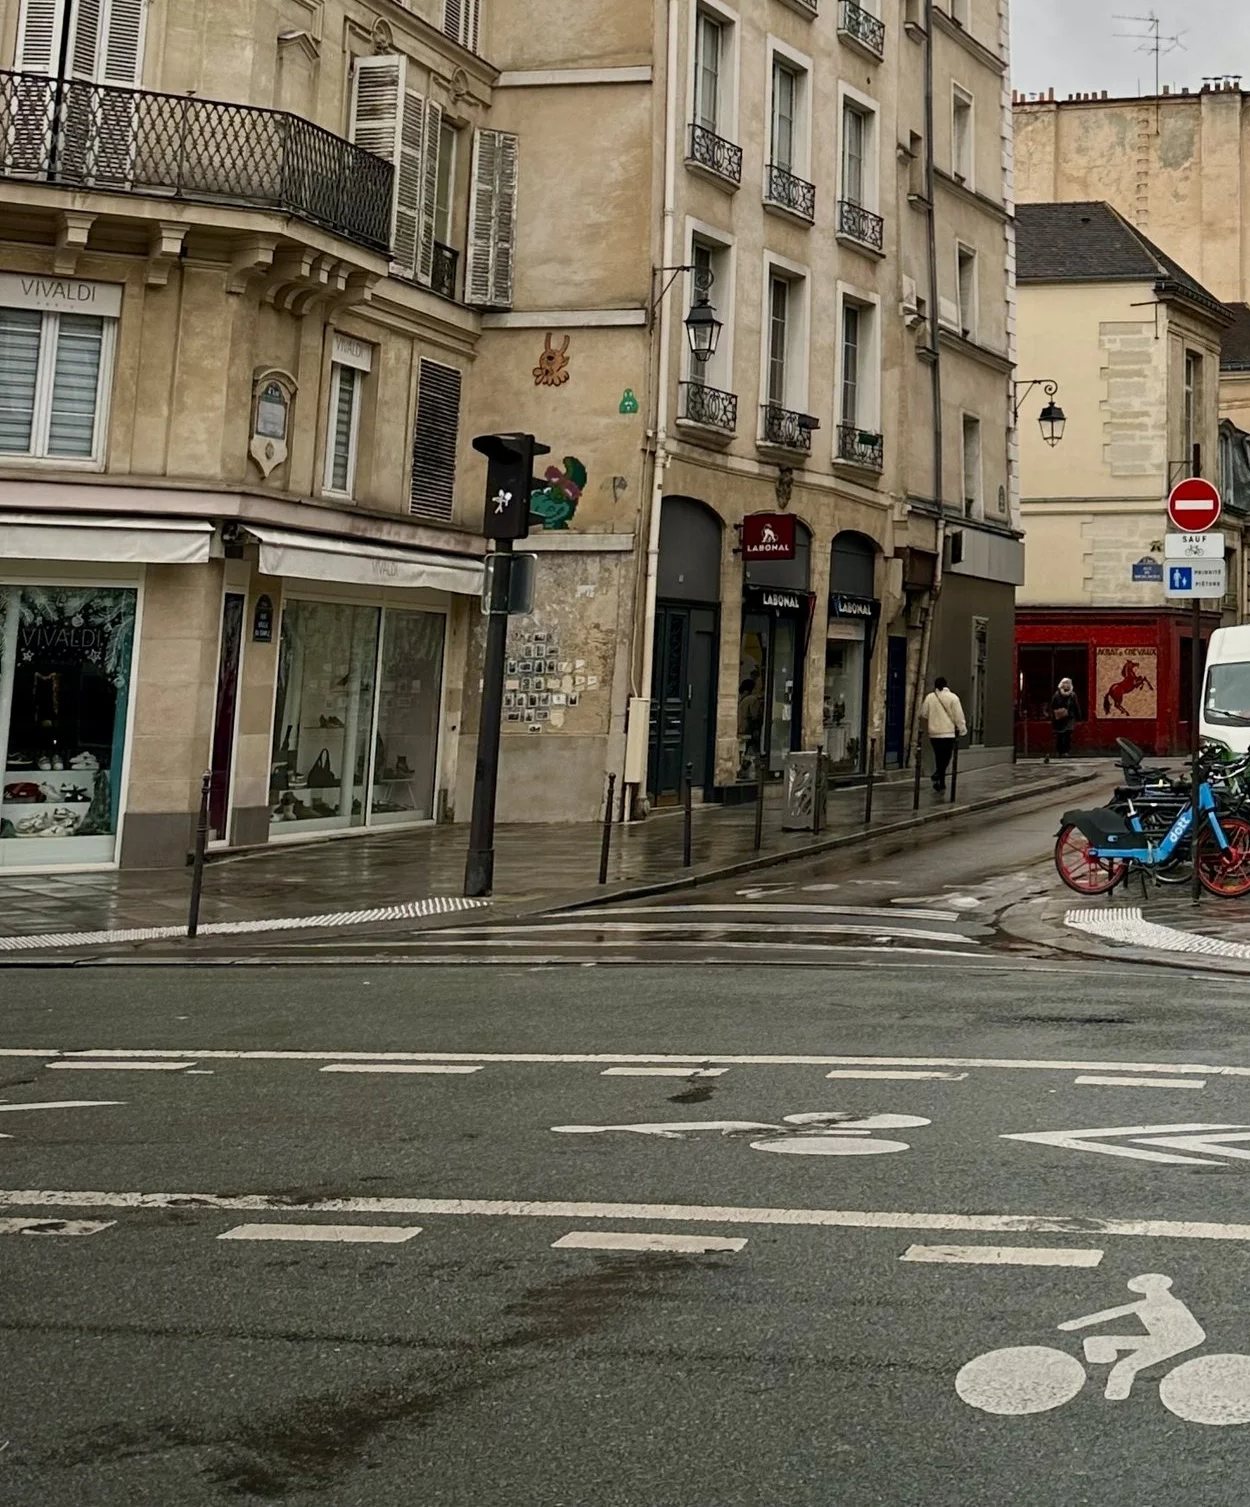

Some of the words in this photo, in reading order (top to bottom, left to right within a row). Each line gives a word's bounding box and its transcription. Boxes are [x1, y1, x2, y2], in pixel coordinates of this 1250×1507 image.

[21, 279, 96, 303] VIVALDI
[1182, 535, 1207, 543] SAUF
[746, 543, 790, 552] LABONAL
[763, 592, 799, 608] LABONAL
[838, 599, 872, 615] LABONAL
[22, 628, 101, 647] VIVALDI
[1170, 815, 1191, 842] dott
